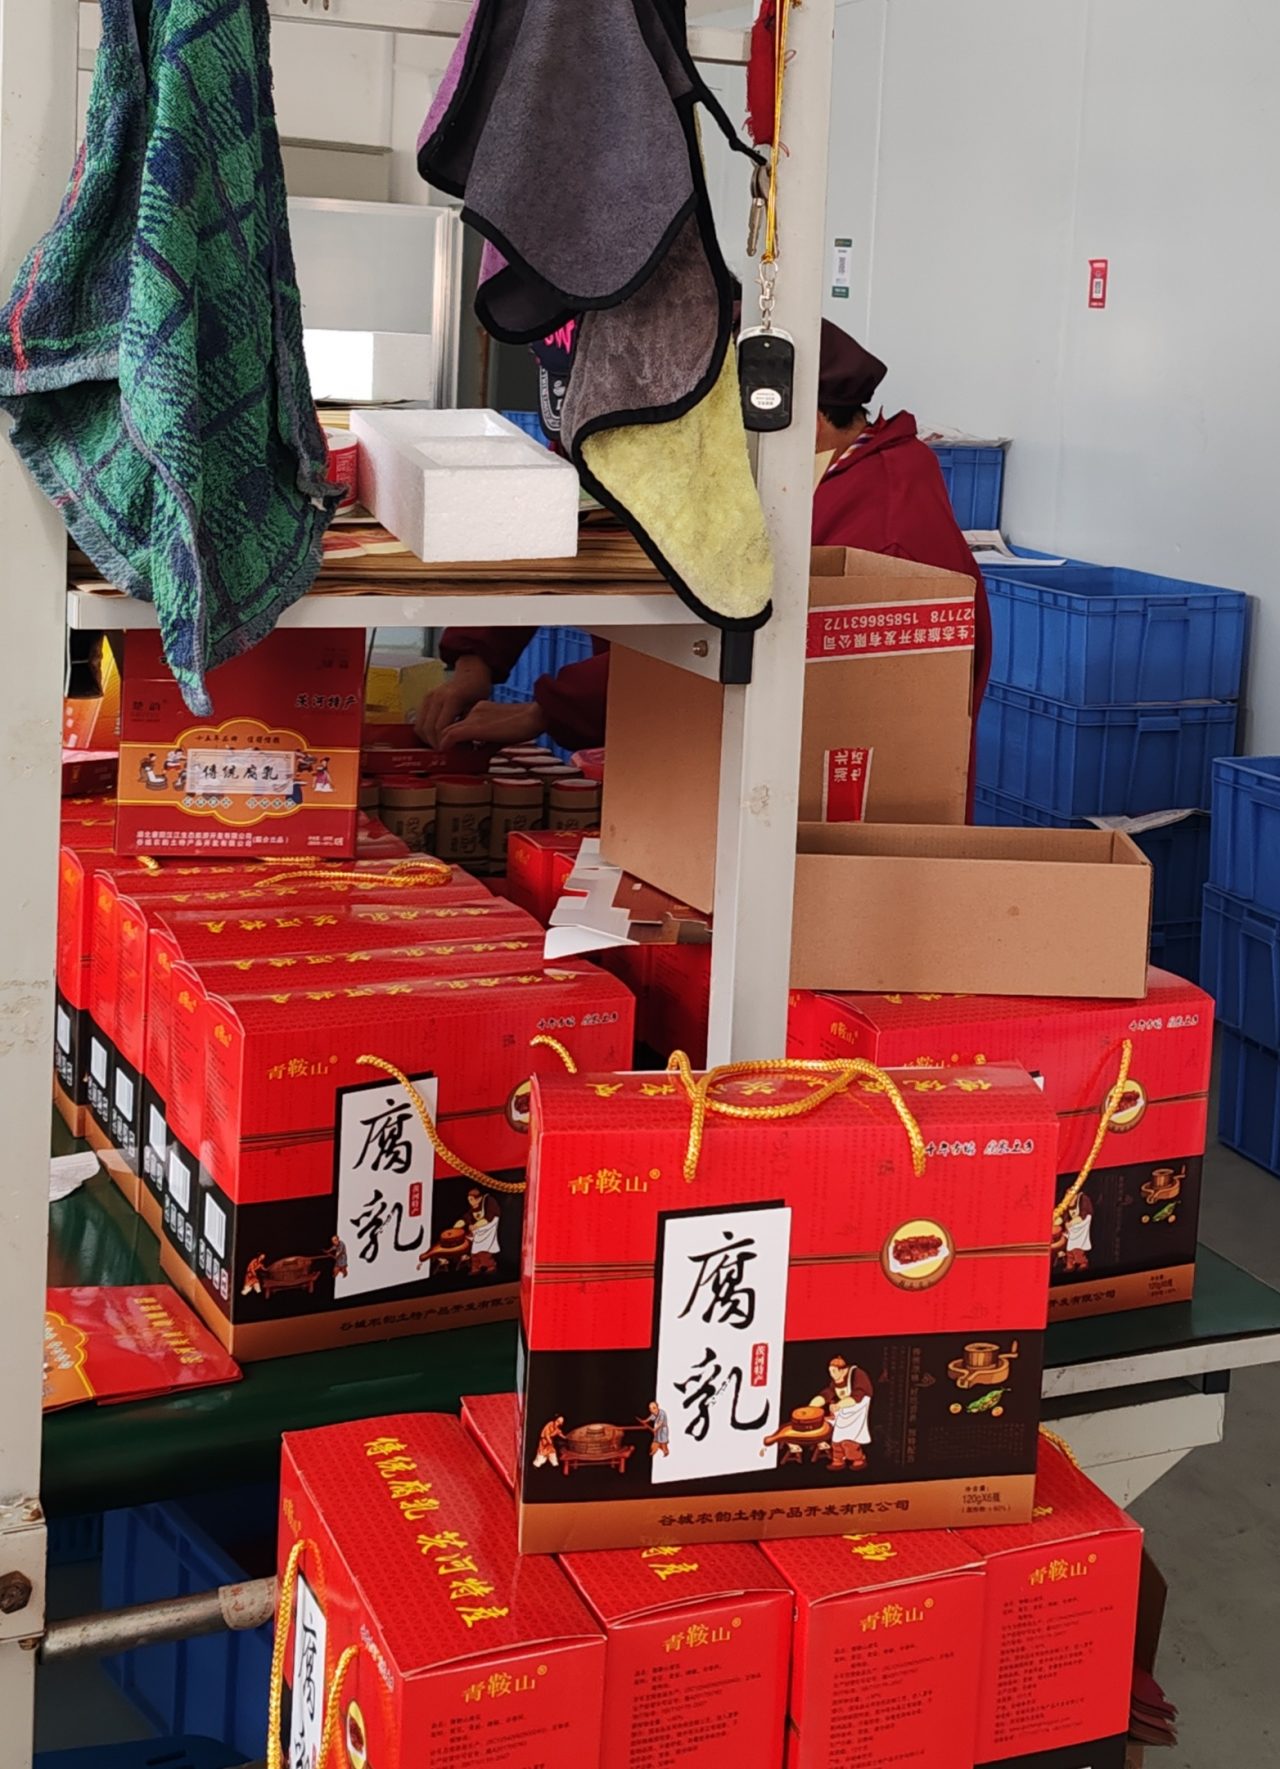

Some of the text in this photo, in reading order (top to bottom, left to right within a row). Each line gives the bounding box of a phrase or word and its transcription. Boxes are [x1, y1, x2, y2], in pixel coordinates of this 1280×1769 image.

[824, 611, 918, 631] 15858663172
[350, 1098, 424, 1263] 腐乳
[567, 1168, 648, 1196] 青鞍山
[673, 1230, 770, 1442] 腐乳
[1028, 1559, 1087, 1586] 青鞍山
[860, 1602, 924, 1632] 青鞍山
[662, 1623, 731, 1653] 青鞍山
[463, 1671, 536, 1703] 青鞍山
